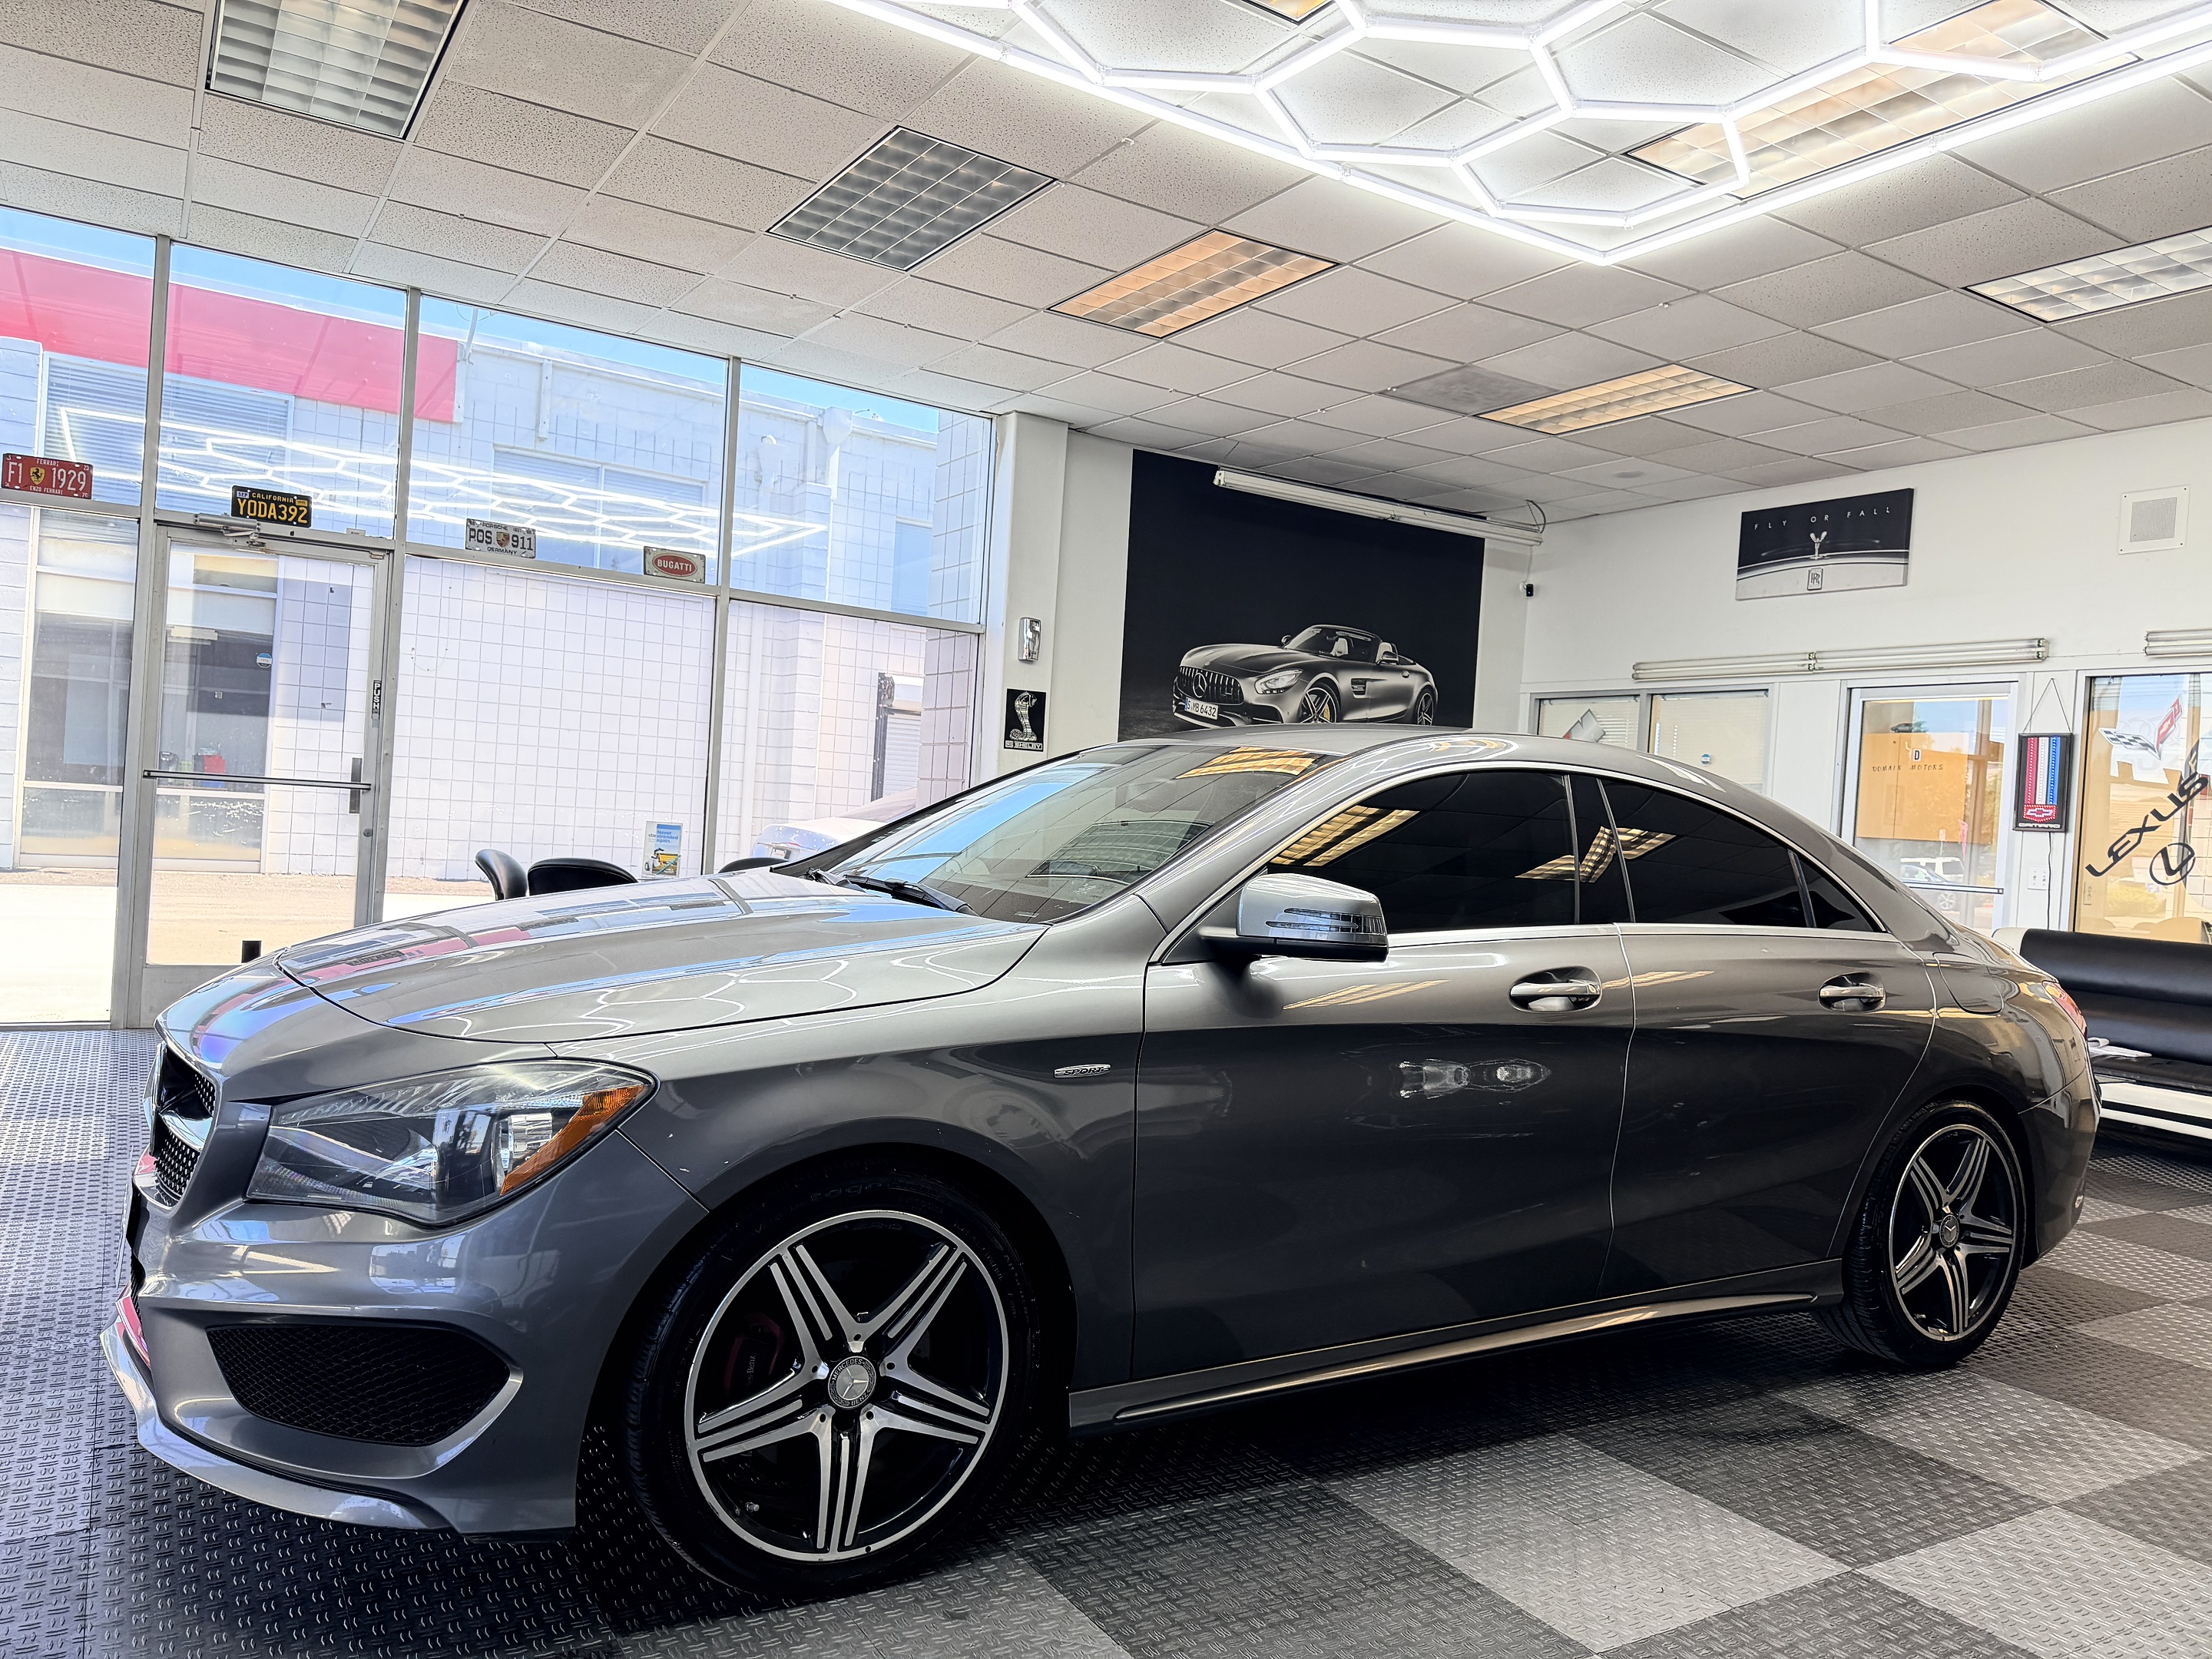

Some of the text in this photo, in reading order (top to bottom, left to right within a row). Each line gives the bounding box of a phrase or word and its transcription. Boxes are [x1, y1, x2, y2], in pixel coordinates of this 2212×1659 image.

[8, 462, 87, 492] F1 1929
[252, 492, 294, 503] CALIFORNIA
[237, 498, 307, 524] YODA392
[1754, 506, 1891, 530] FLY OR FALL
[482, 522, 508, 531] PORSCHE
[469, 528, 533, 551] POS 911
[487, 546, 517, 555] GERMANY
[657, 558, 692, 572] BUGATTI
[1200, 704, 1217, 717] 6432
[1914, 750, 1920, 760] D
[2085, 772, 2208, 876] LEXUS
[1063, 1067, 1104, 1076] SPORT
[831, 1358, 863, 1380] MERCEDES
[851, 1392, 869, 1406] BENZ
